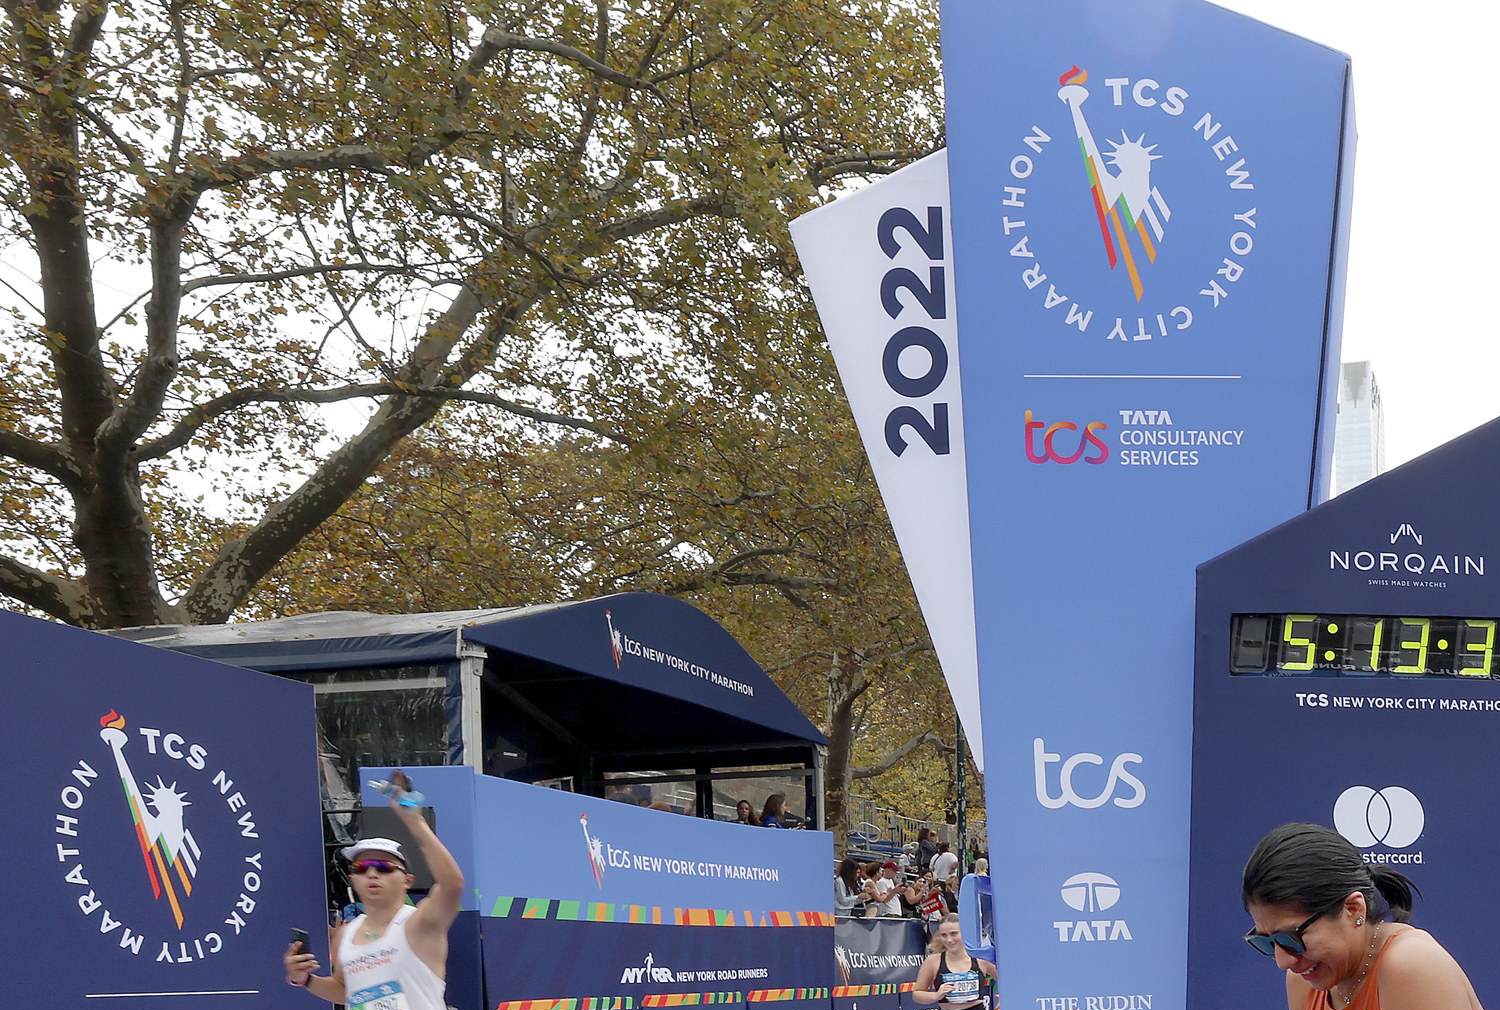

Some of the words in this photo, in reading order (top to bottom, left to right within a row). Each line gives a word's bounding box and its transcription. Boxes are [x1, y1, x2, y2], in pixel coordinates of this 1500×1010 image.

[1104, 77, 1189, 116] TCS
[1193, 112, 1254, 190] NEW
[1002, 125, 1093, 332] MARATHON
[1199, 207, 1257, 308] YORK
[877, 206, 950, 458] 2022
[1107, 306, 1193, 341] CITY
[1024, 409, 1109, 465] tcs
[1120, 410, 1173, 425] TATA
[1120, 430, 1244, 446] CONSULTANCY
[1120, 450, 1199, 466] SERVICES
[1330, 551, 1484, 575] NORQAIN
[624, 635, 641, 657] tcs
[643, 646, 664, 664] NEW
[666, 654, 689, 673] YORK
[690, 663, 710, 681] CITY
[711, 671, 754, 697] MARATHON
[1296, 693, 1328, 707] TCS
[1333, 696, 1365, 708] NEW
[1366, 697, 1403, 709] YORK
[1405, 698, 1437, 710] CITY
[140, 727, 208, 769] TCS
[1034, 737, 1147, 809] tcs
[212, 769, 259, 840] NEW
[55, 760, 144, 955] MARATHON
[607, 843, 631, 869] tcs
[634, 855, 662, 873] NEW
[664, 859, 696, 876] YORK
[698, 862, 722, 878] CITY
[724, 865, 779, 882] MARATHON
[1360, 851, 1422, 864] stercard
[224, 852, 262, 934] YORK
[156, 932, 222, 963] CITY
[1053, 920, 1133, 942] TATA
[676, 971, 695, 982] NEW
[696, 970, 717, 981] YORK
[717, 969, 737, 981] ROAD
[738, 968, 768, 980] RUNNERS
[848, 949, 867, 968] tcs
[867, 955, 887, 968] NEW
[886, 954, 910, 967] YORK
[908, 954, 925, 967] CITY
